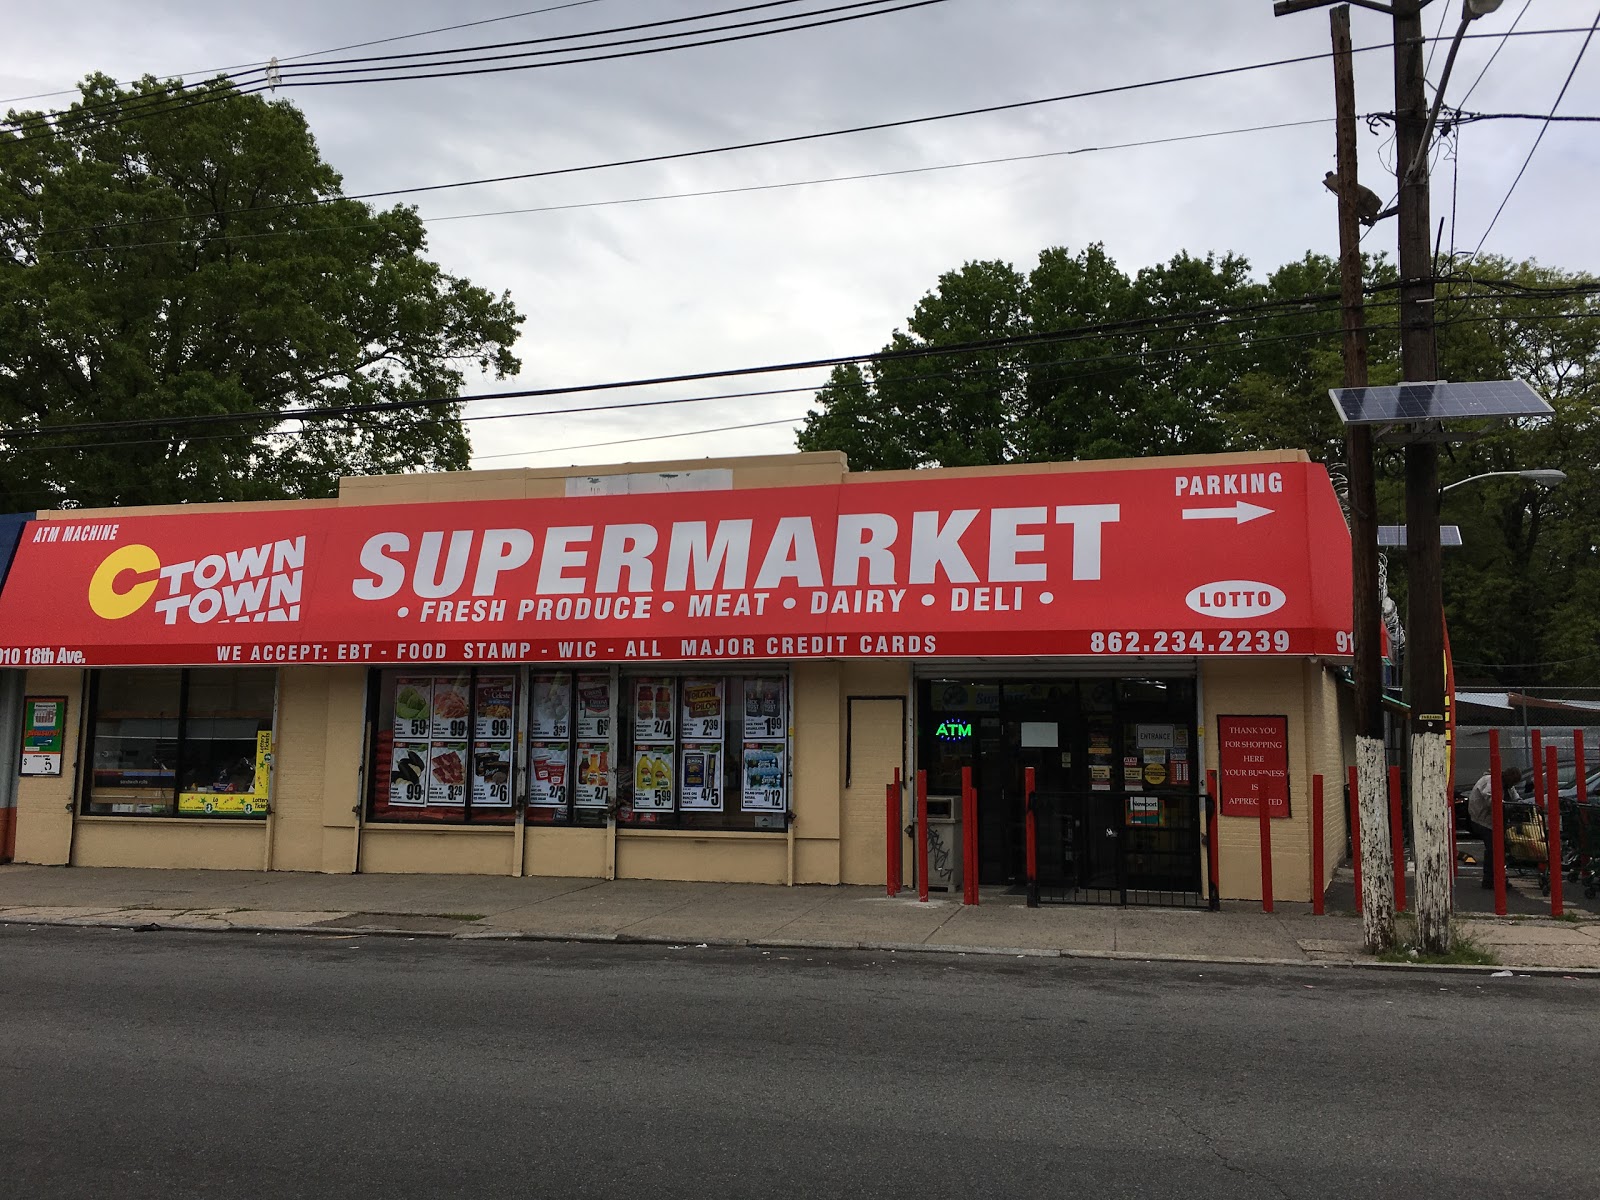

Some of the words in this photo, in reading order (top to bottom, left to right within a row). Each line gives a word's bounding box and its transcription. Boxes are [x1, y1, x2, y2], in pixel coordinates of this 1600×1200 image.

[1175, 472, 1283, 497] PARKING
[33, 526, 58, 543] ATM
[61, 524, 120, 542] MACHINE
[352, 503, 1121, 601] SUPERMARKET
[154, 569, 304, 625] TOWN
[419, 599, 508, 623] FRESH
[517, 595, 653, 621] PRODUCE
[687, 592, 770, 618] MEAT
[810, 588, 907, 614] DAIRY
[950, 586, 1023, 612] DELI
[1198, 590, 1272, 608] LOTTO
[217, 645, 242, 661] WE
[250, 644, 329, 661] ACCEPT:
[337, 643, 373, 660] EBT
[397, 642, 447, 659] FOOD
[463, 642, 532, 659] STAMP
[558, 641, 597, 658] WIC
[625, 640, 662, 657] ALL
[680, 637, 756, 656] MAJOR
[766, 635, 849, 655] CREDIT
[860, 634, 937, 654] CARDS
[1090, 630, 1290, 653] 862.234.2239
[24, 647, 55, 664] 18th
[56, 647, 86, 664] Ave.
[695, 702, 717, 711] PILON
[935, 723, 972, 737] ATM
[1140, 732, 1171, 740] ENTRANCE
[1259, 727, 1277, 735] YOU
[1241, 741, 1282, 749] SHOPPING
[490, 784, 507, 801] 2/6
[549, 785, 566, 802] 2/3
[700, 788, 719, 805] 4/5
[1228, 797, 1283, 806] APPRECTED
